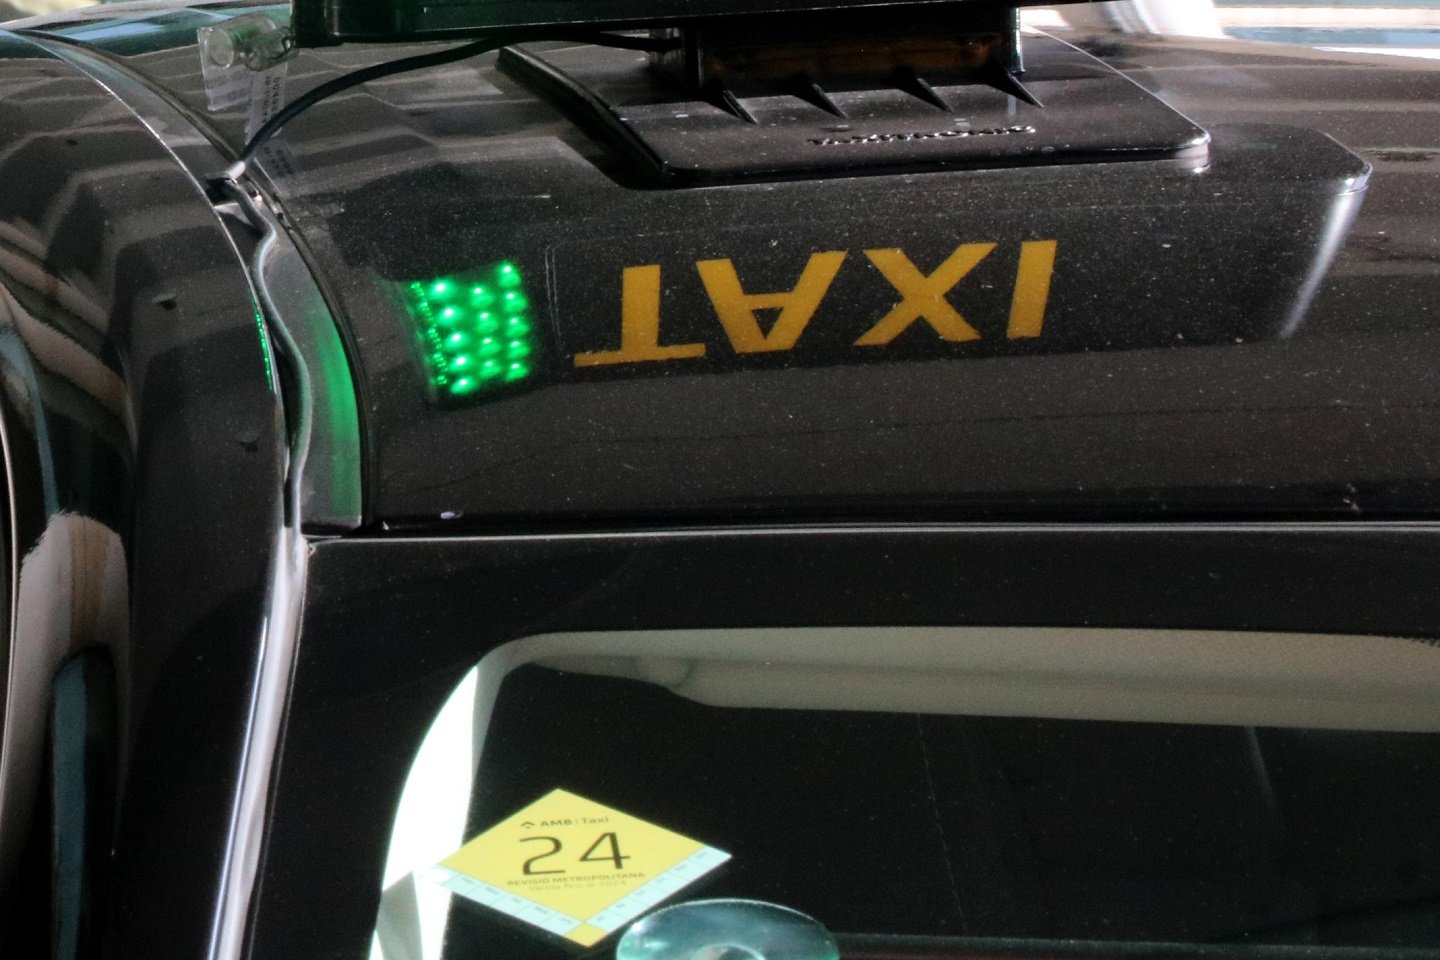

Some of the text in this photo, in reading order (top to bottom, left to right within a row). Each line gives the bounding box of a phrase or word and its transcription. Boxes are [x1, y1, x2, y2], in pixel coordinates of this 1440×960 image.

[540, 819, 572, 827] AMB
[519, 832, 631, 876] 24
[552, 872, 645, 883] METROPOLITANA
